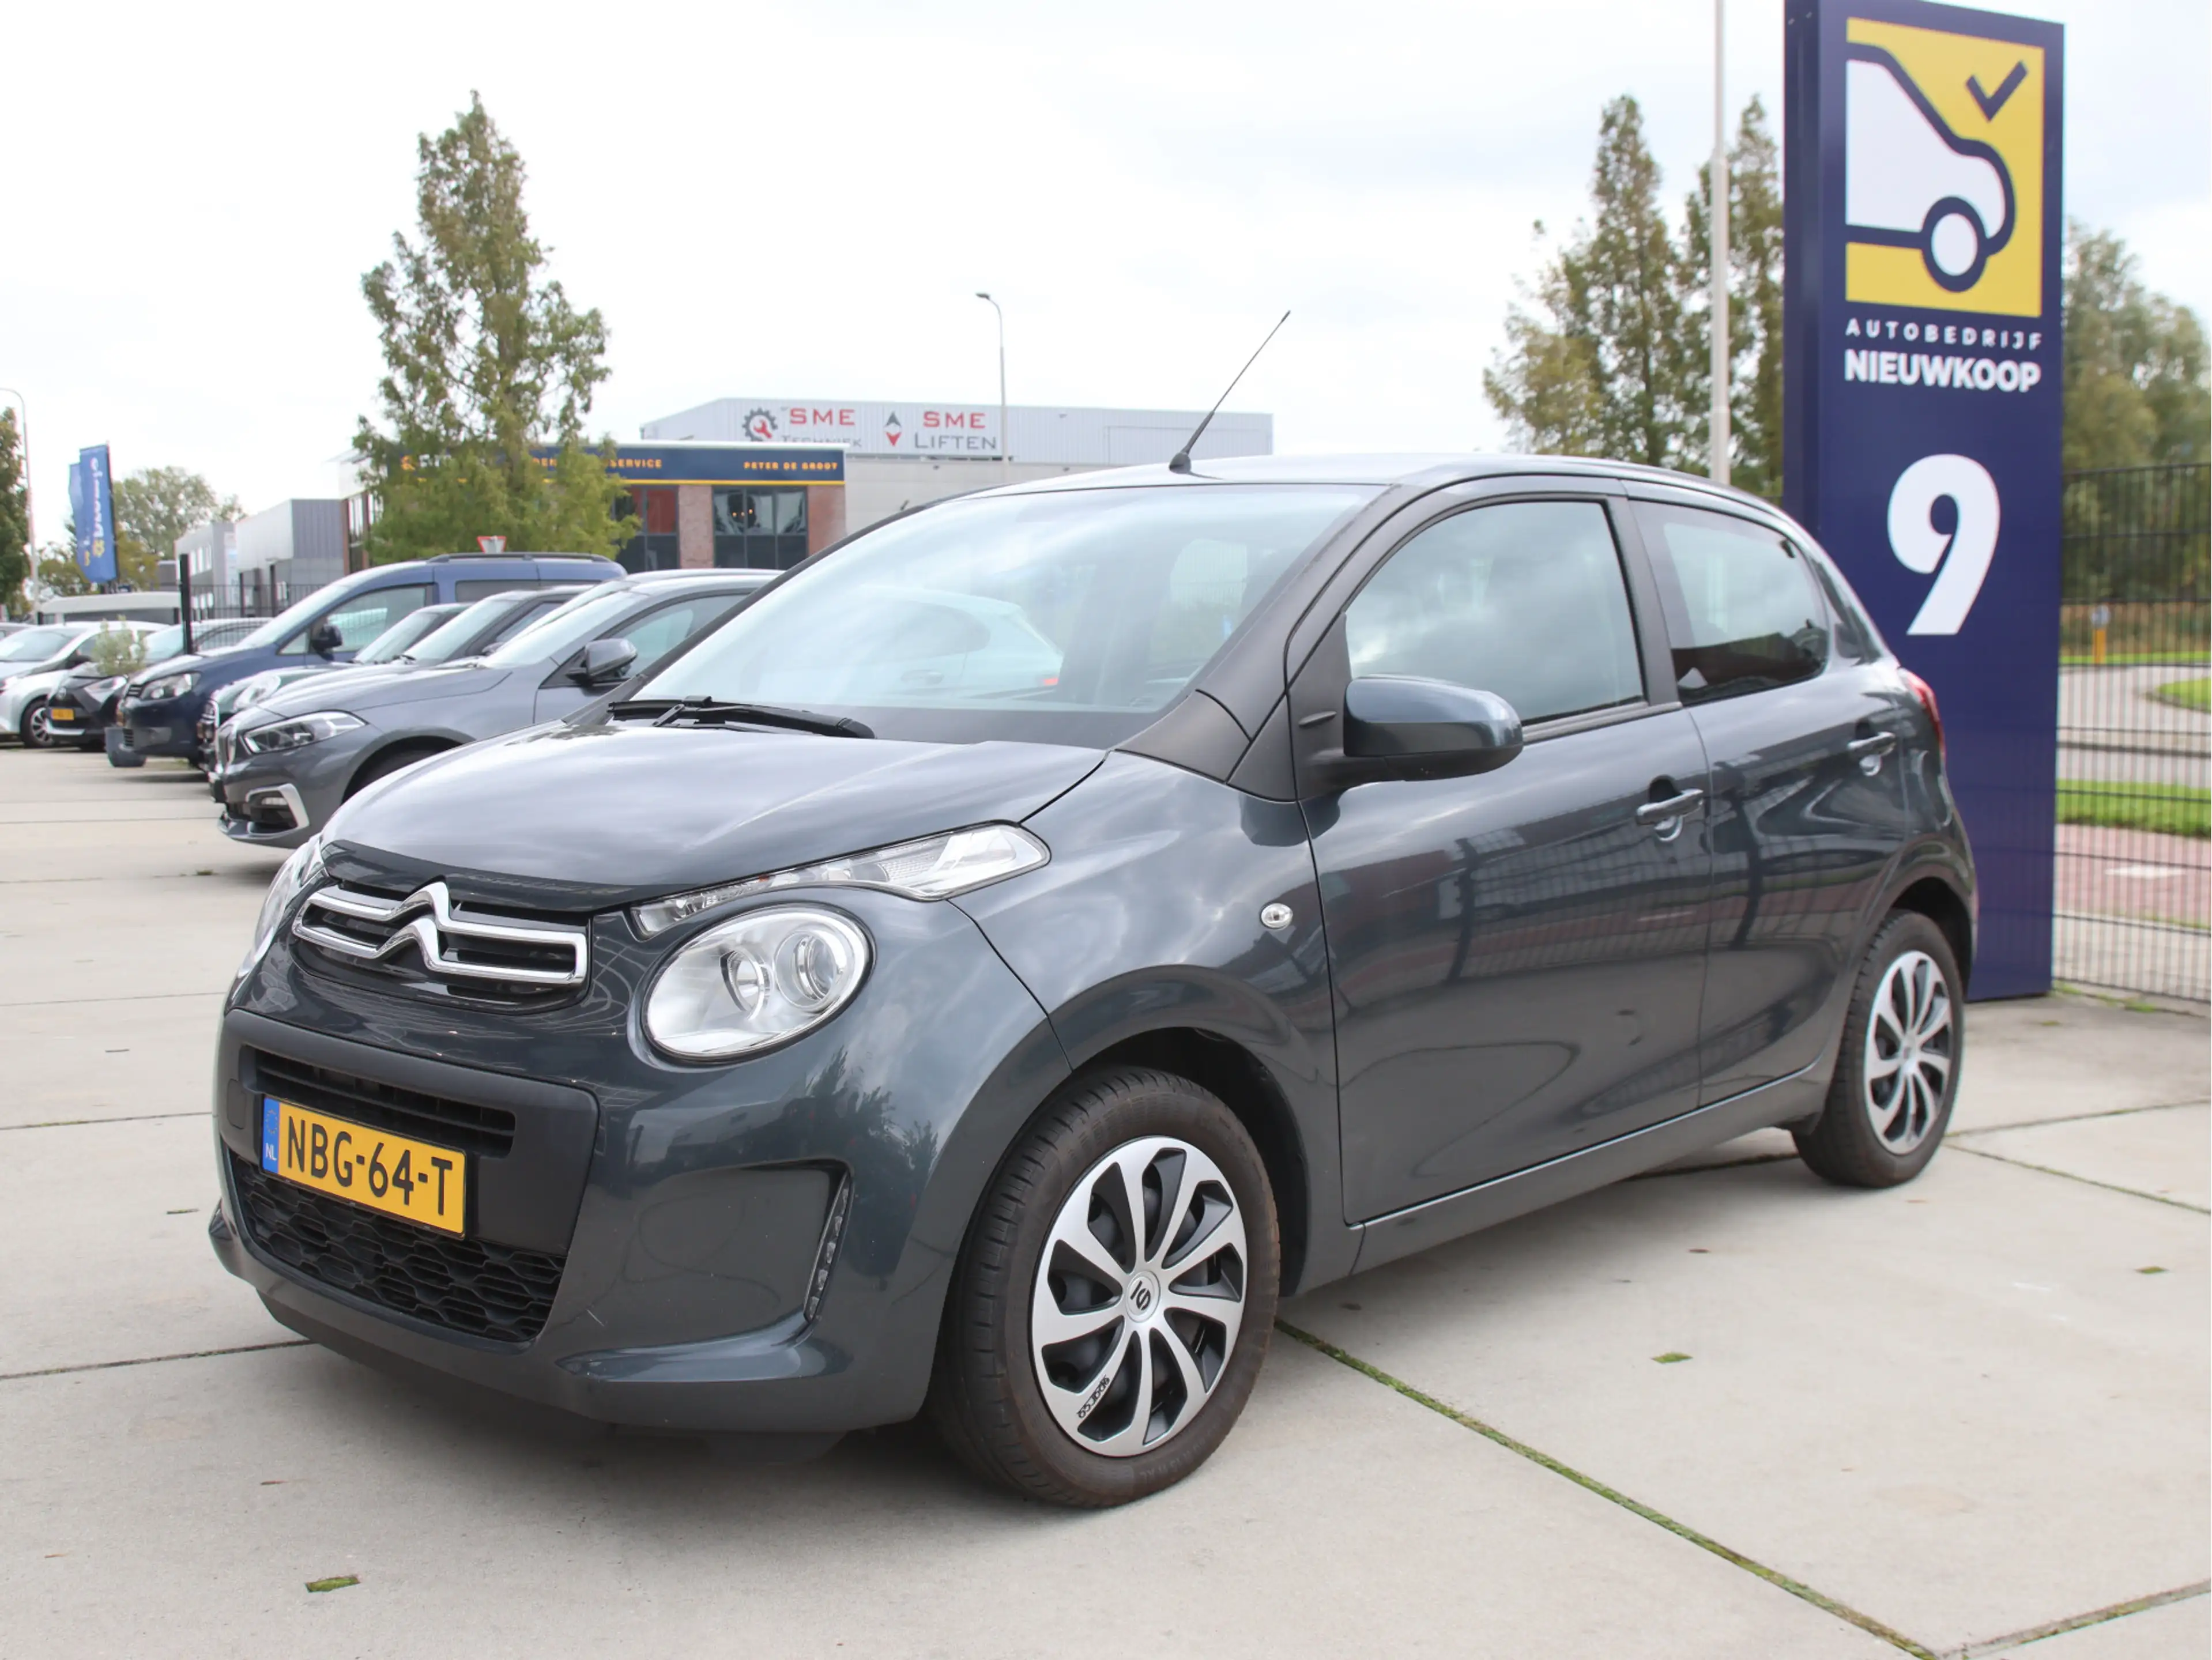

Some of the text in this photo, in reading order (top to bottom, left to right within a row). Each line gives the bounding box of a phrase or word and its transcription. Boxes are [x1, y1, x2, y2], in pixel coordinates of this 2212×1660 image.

[1845, 318, 2042, 350] AUTOBEDRIJF
[1845, 348, 2041, 393] NIEUWKOOP
[790, 408, 856, 426] SME
[923, 410, 986, 429] SME
[914, 432, 997, 450] LIFTEN
[744, 461, 838, 470] PETER DE GROOT
[1887, 454, 2000, 635] 9
[265, 1115, 453, 1216] NL NBG-64-T
